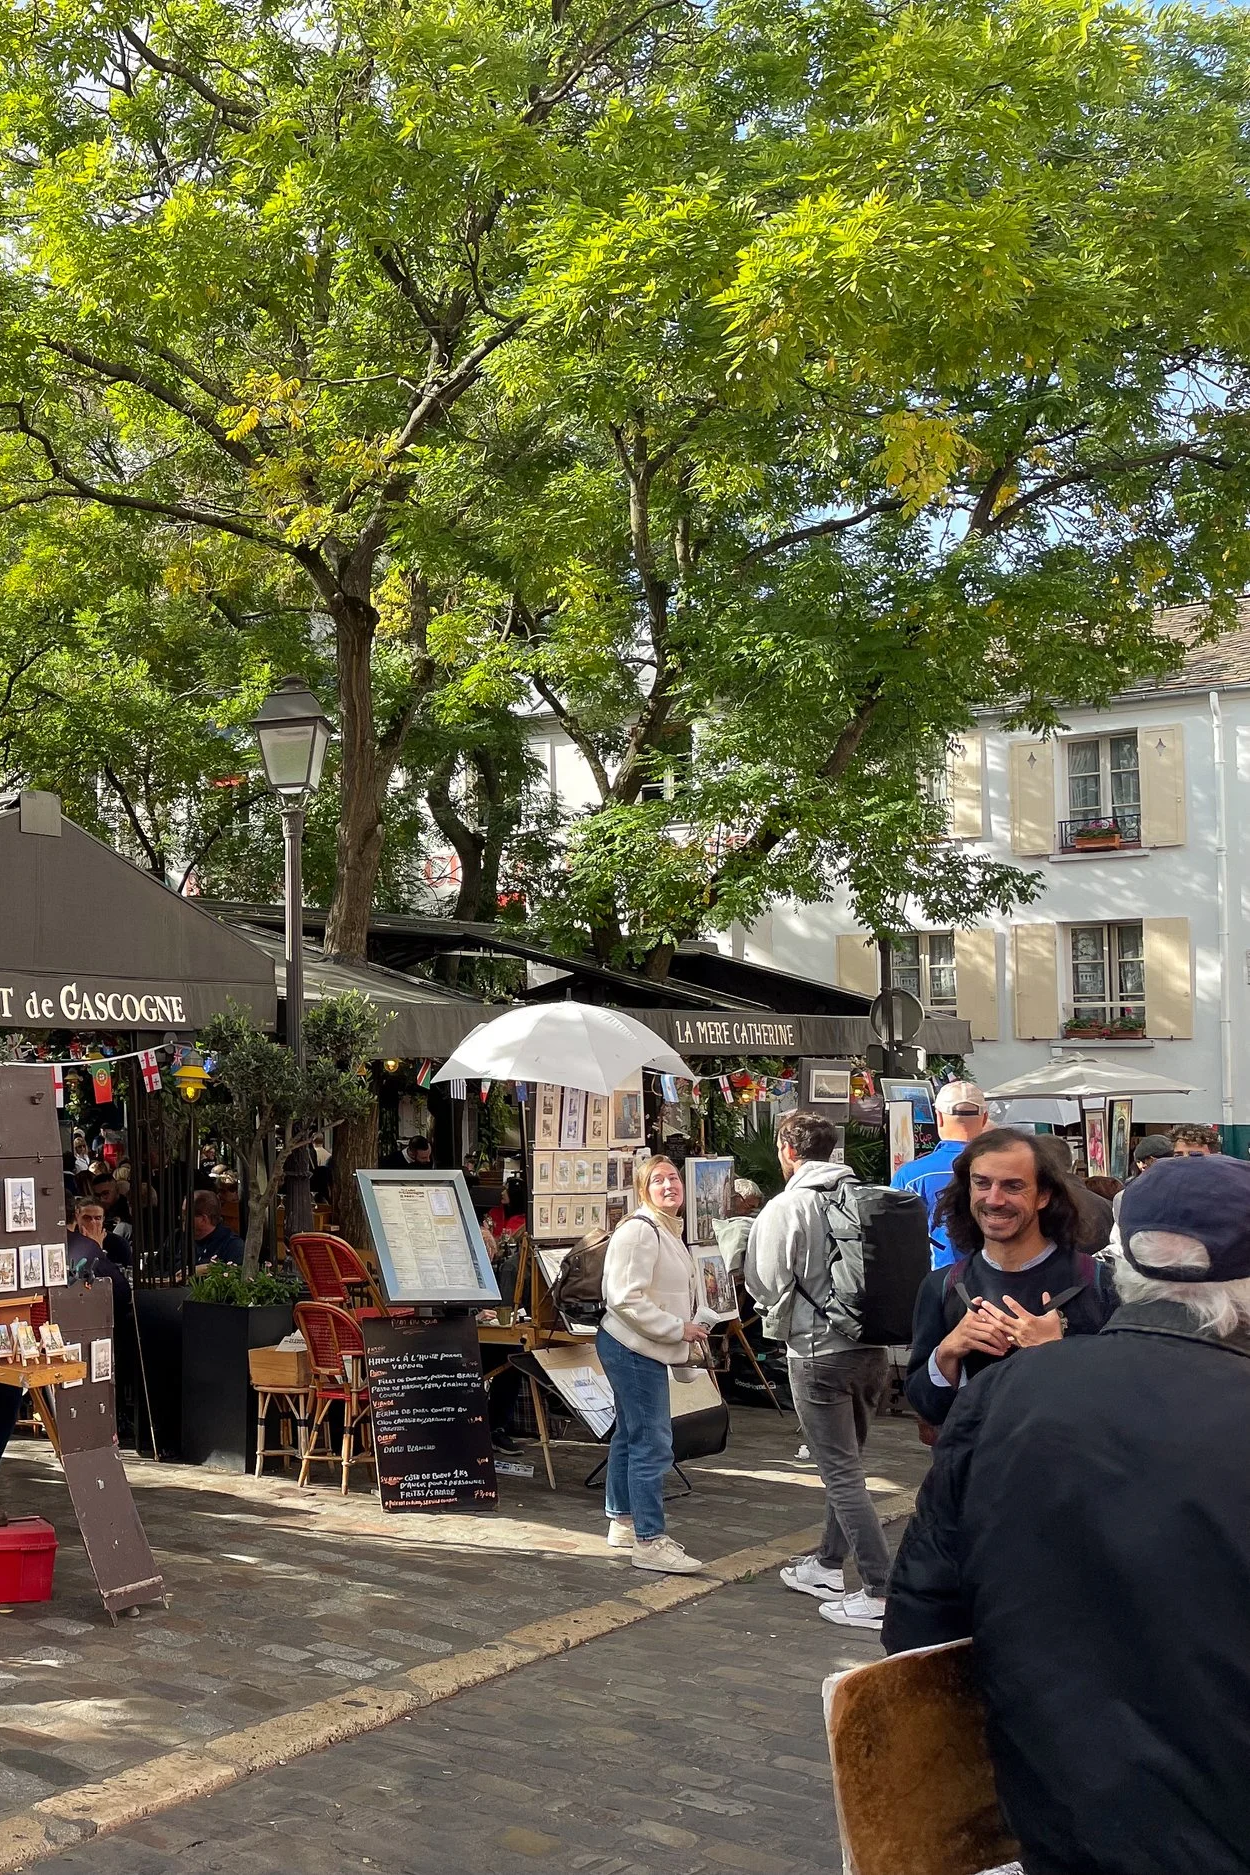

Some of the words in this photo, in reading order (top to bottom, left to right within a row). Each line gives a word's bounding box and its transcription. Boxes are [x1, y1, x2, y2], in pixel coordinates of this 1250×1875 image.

[25, 990, 55, 1019] de
[59, 982, 186, 1023] GASCOGNE
[676, 1020, 694, 1044] LA
[696, 1021, 731, 1045] MERE
[733, 1022, 795, 1046] CATHERINE
